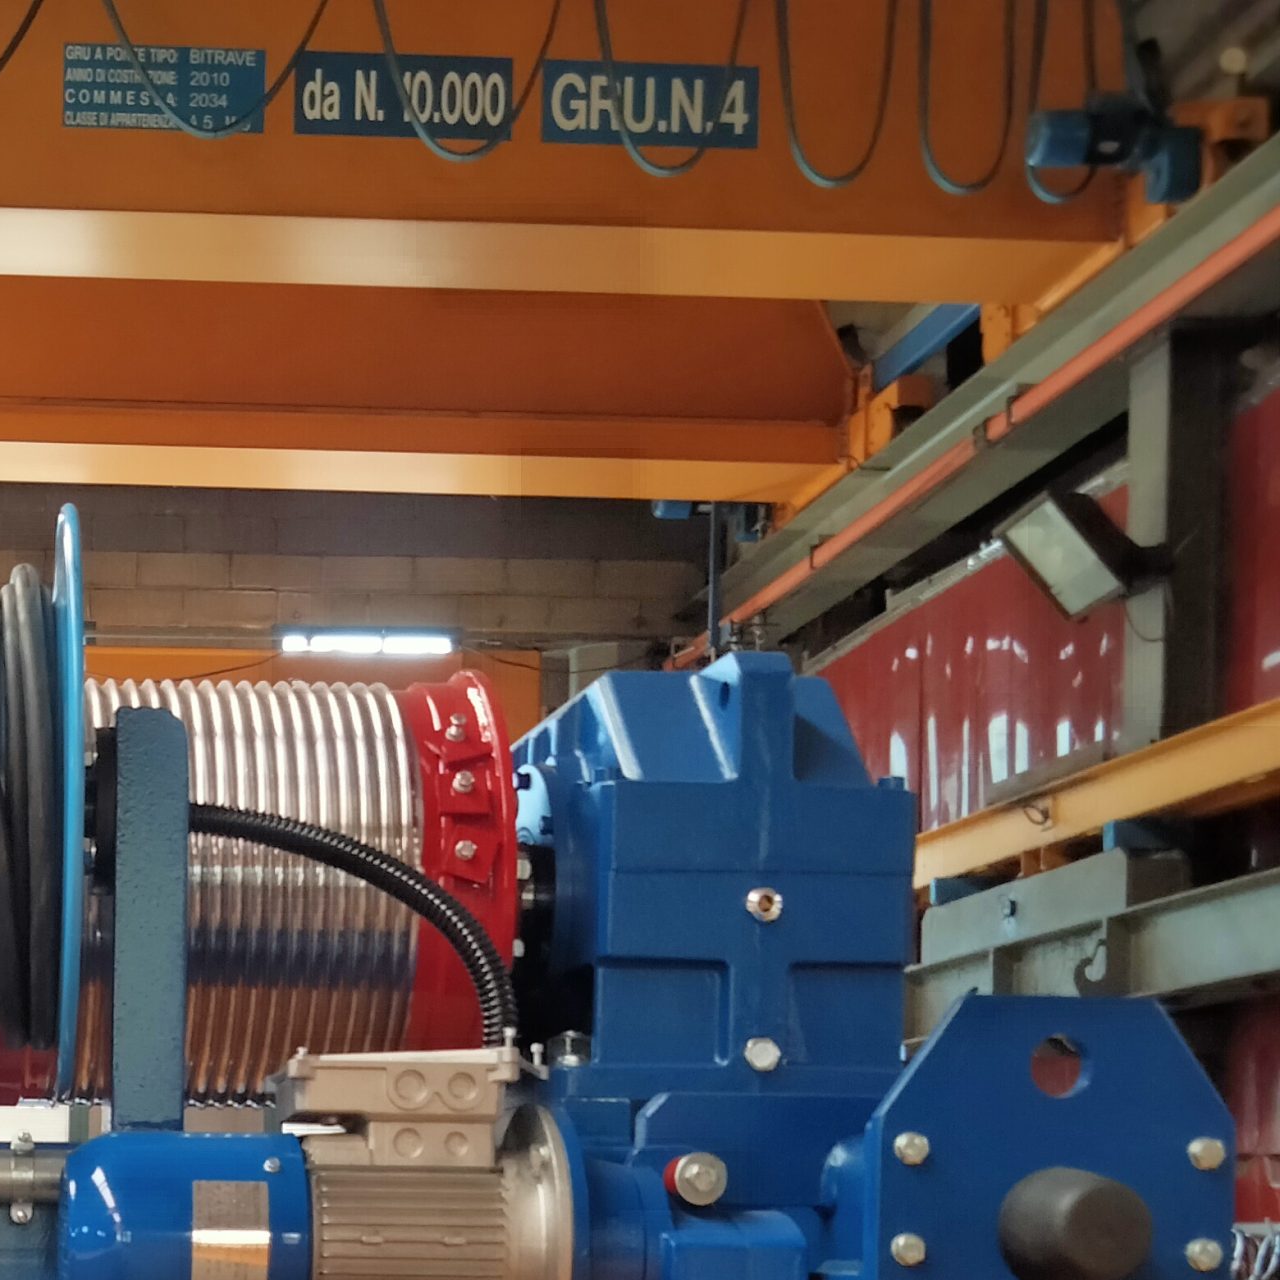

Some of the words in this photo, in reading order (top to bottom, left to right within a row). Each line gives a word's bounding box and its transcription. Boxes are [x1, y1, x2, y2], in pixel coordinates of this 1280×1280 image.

[65, 45, 91, 61] GRU
[94, 46, 103, 61] A
[189, 49, 256, 66] BITRAVE
[65, 68, 93, 82] ANNO
[95, 68, 106, 83] DI
[189, 72, 230, 87] 2010
[189, 92, 228, 108] 2034
[302, 68, 340, 121] da
[354, 69, 384, 122] N.
[64, 111, 97, 126] CLASSE
